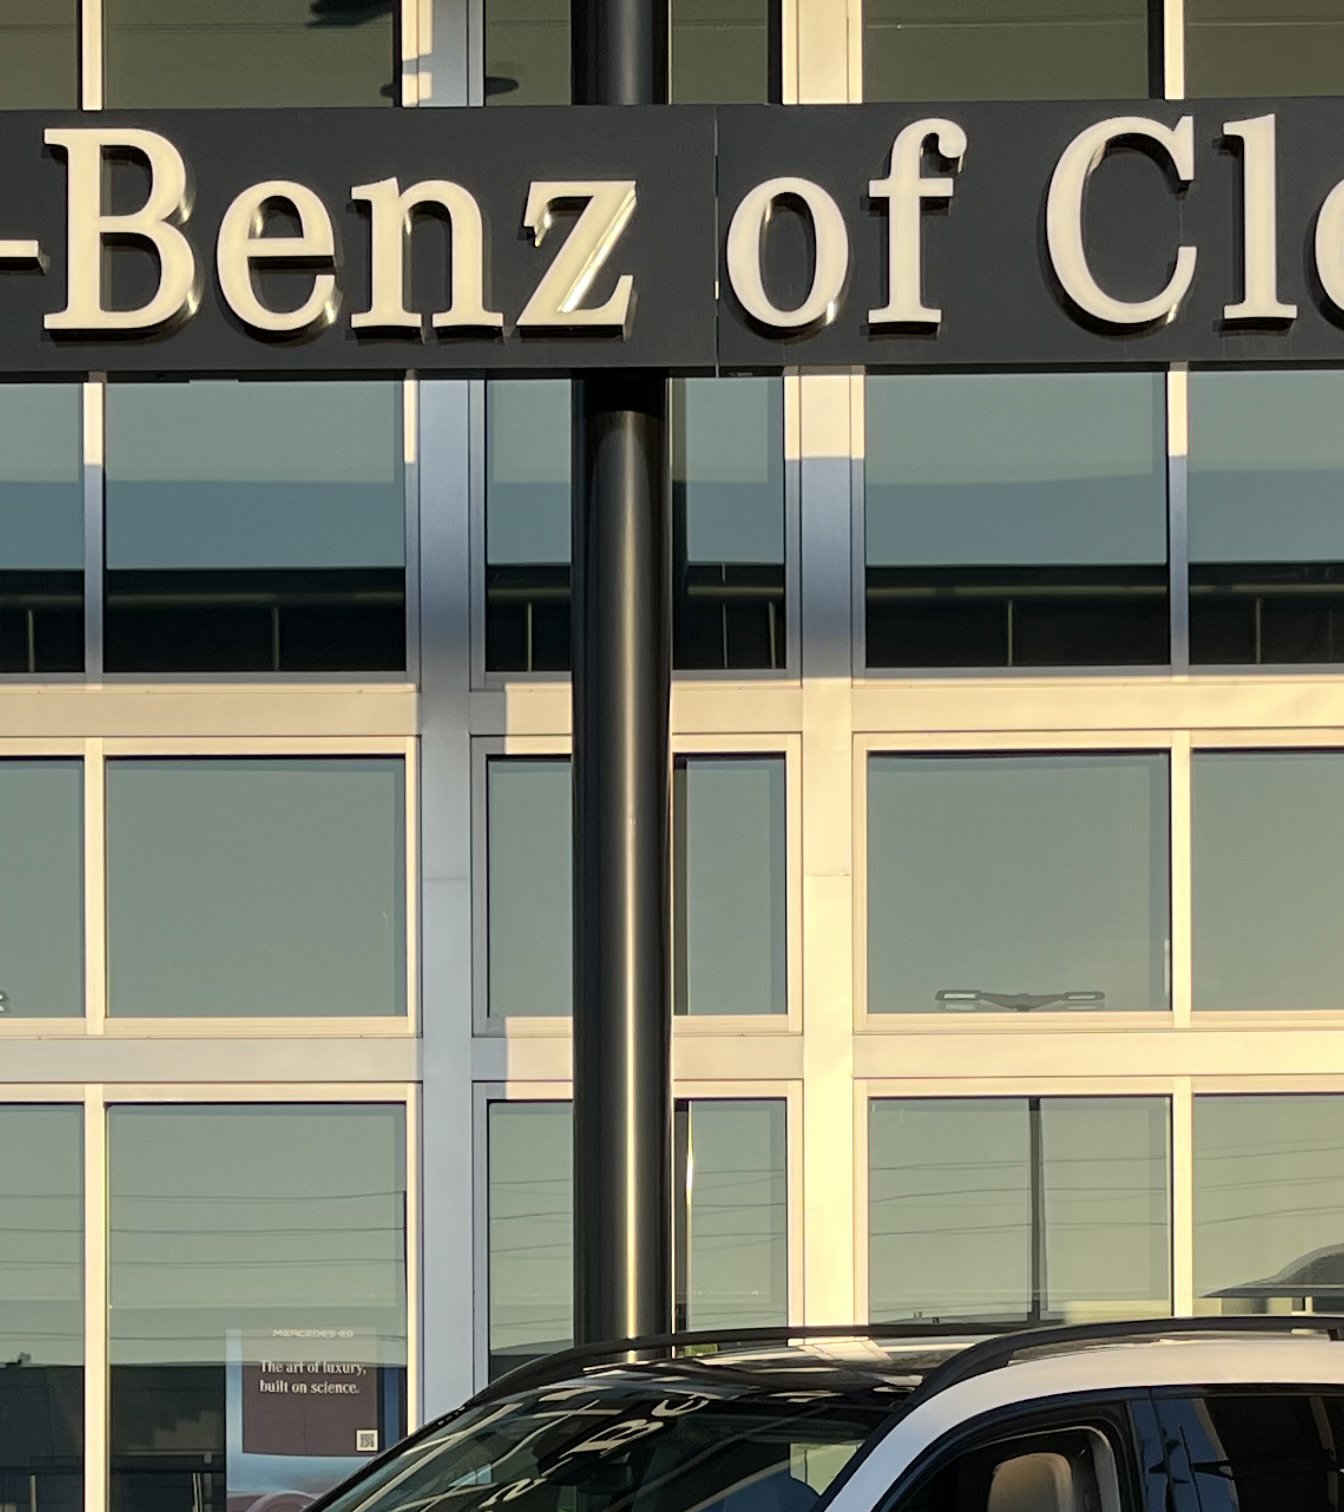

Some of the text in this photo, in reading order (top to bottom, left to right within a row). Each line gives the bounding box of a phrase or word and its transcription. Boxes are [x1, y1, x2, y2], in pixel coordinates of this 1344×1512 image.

[725, 116, 967, 328] of
[260, 1360, 367, 1377] The art of luxury,
[259, 1380, 360, 1394] built on science.
